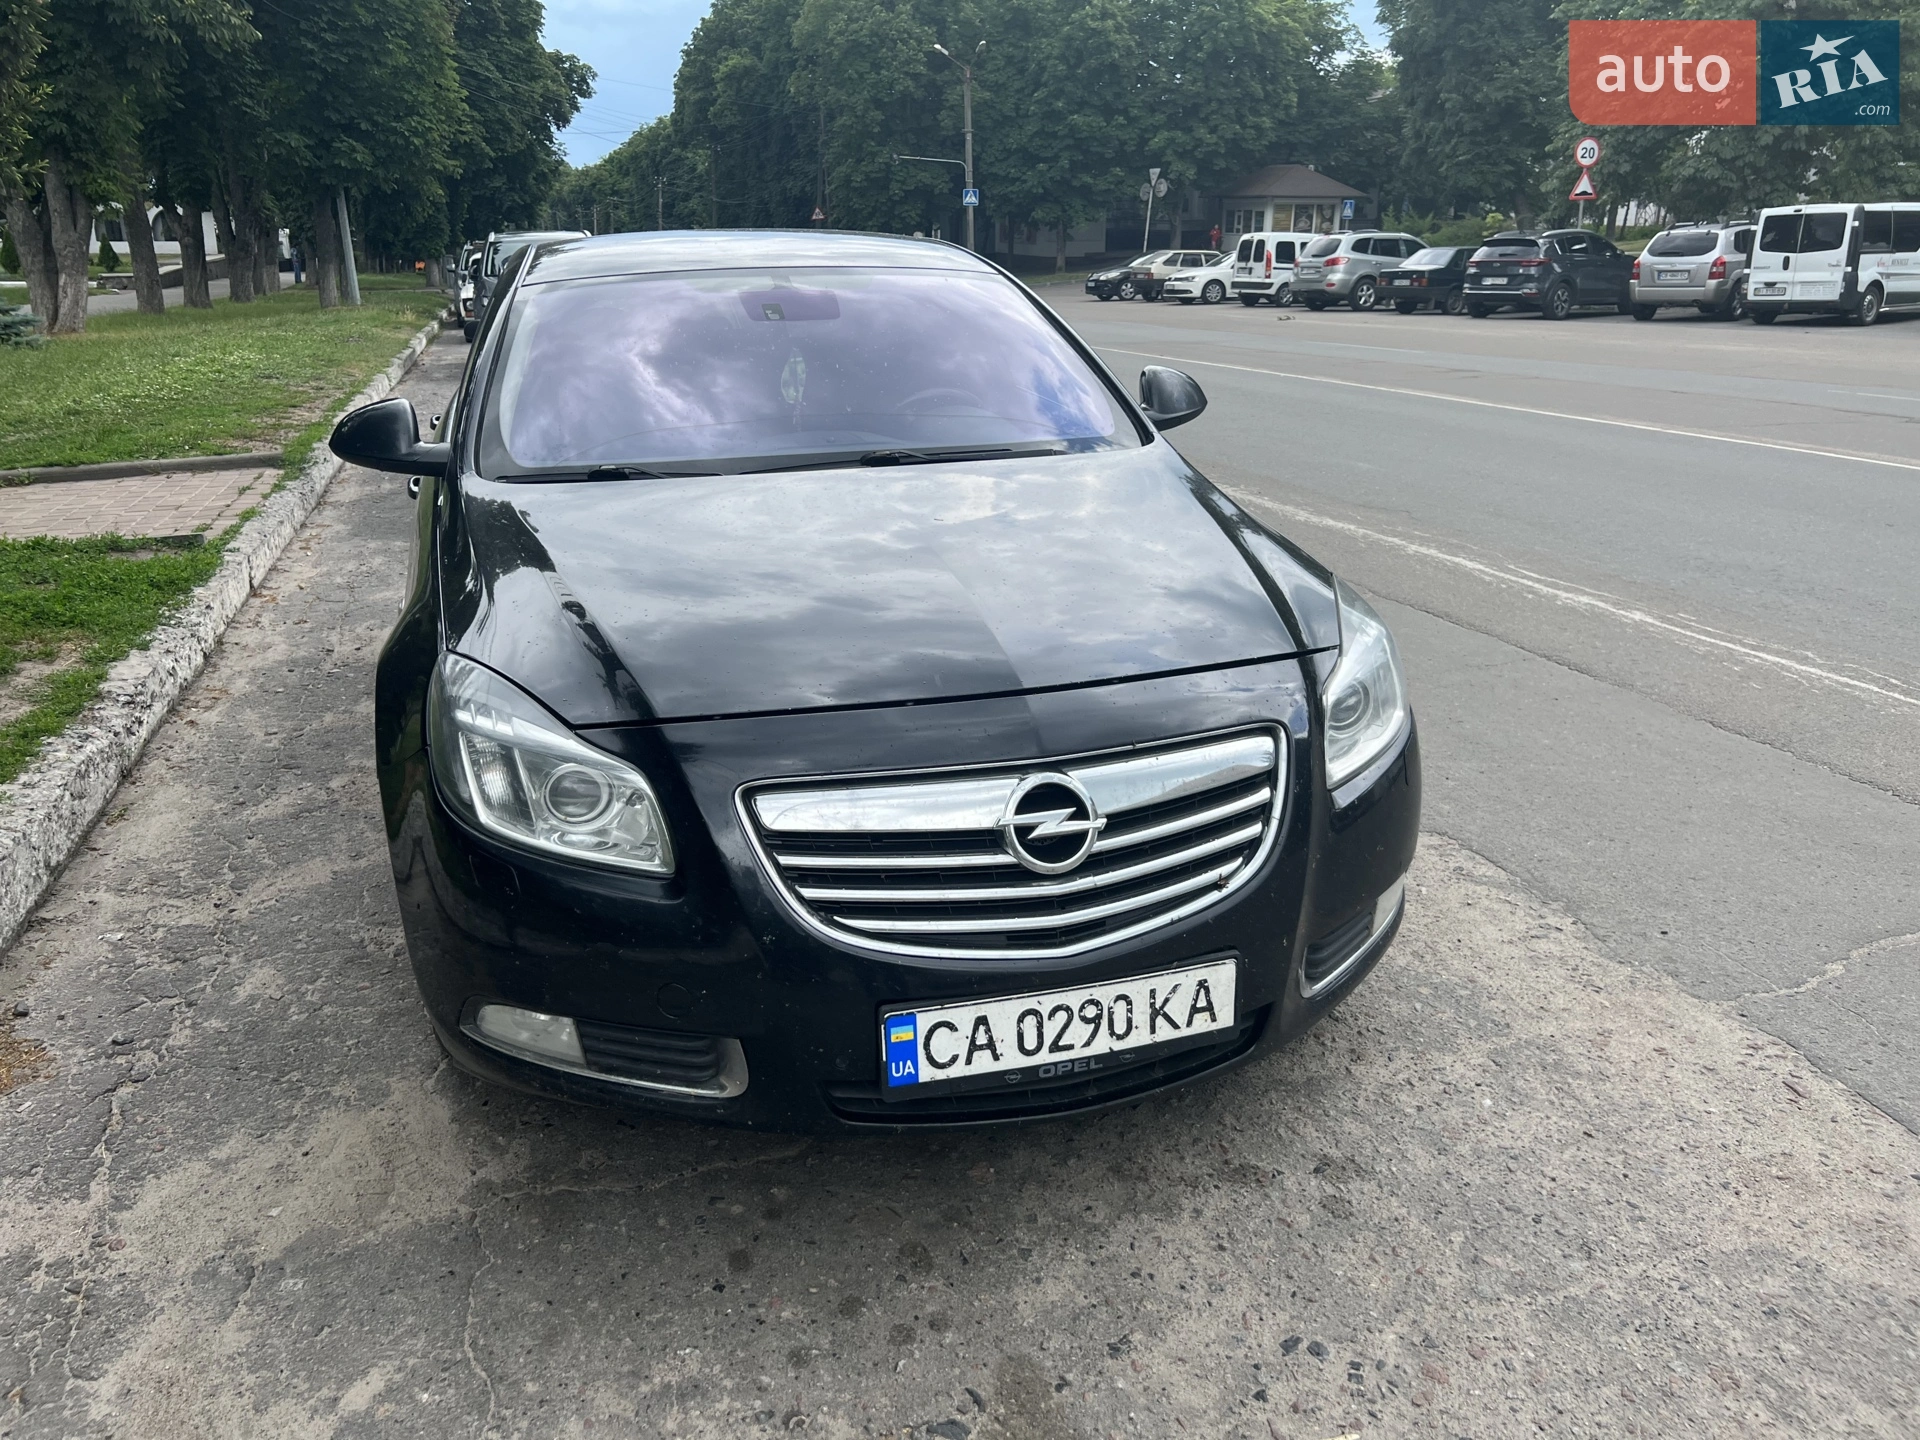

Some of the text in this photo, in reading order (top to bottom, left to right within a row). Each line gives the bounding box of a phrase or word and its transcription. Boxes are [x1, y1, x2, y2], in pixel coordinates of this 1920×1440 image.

[1580, 147, 1596, 160] 20
[922, 978, 1218, 1070] CA 0290 KA
[891, 1061, 916, 1078] UA
[1039, 1058, 1103, 1078] OPEL
